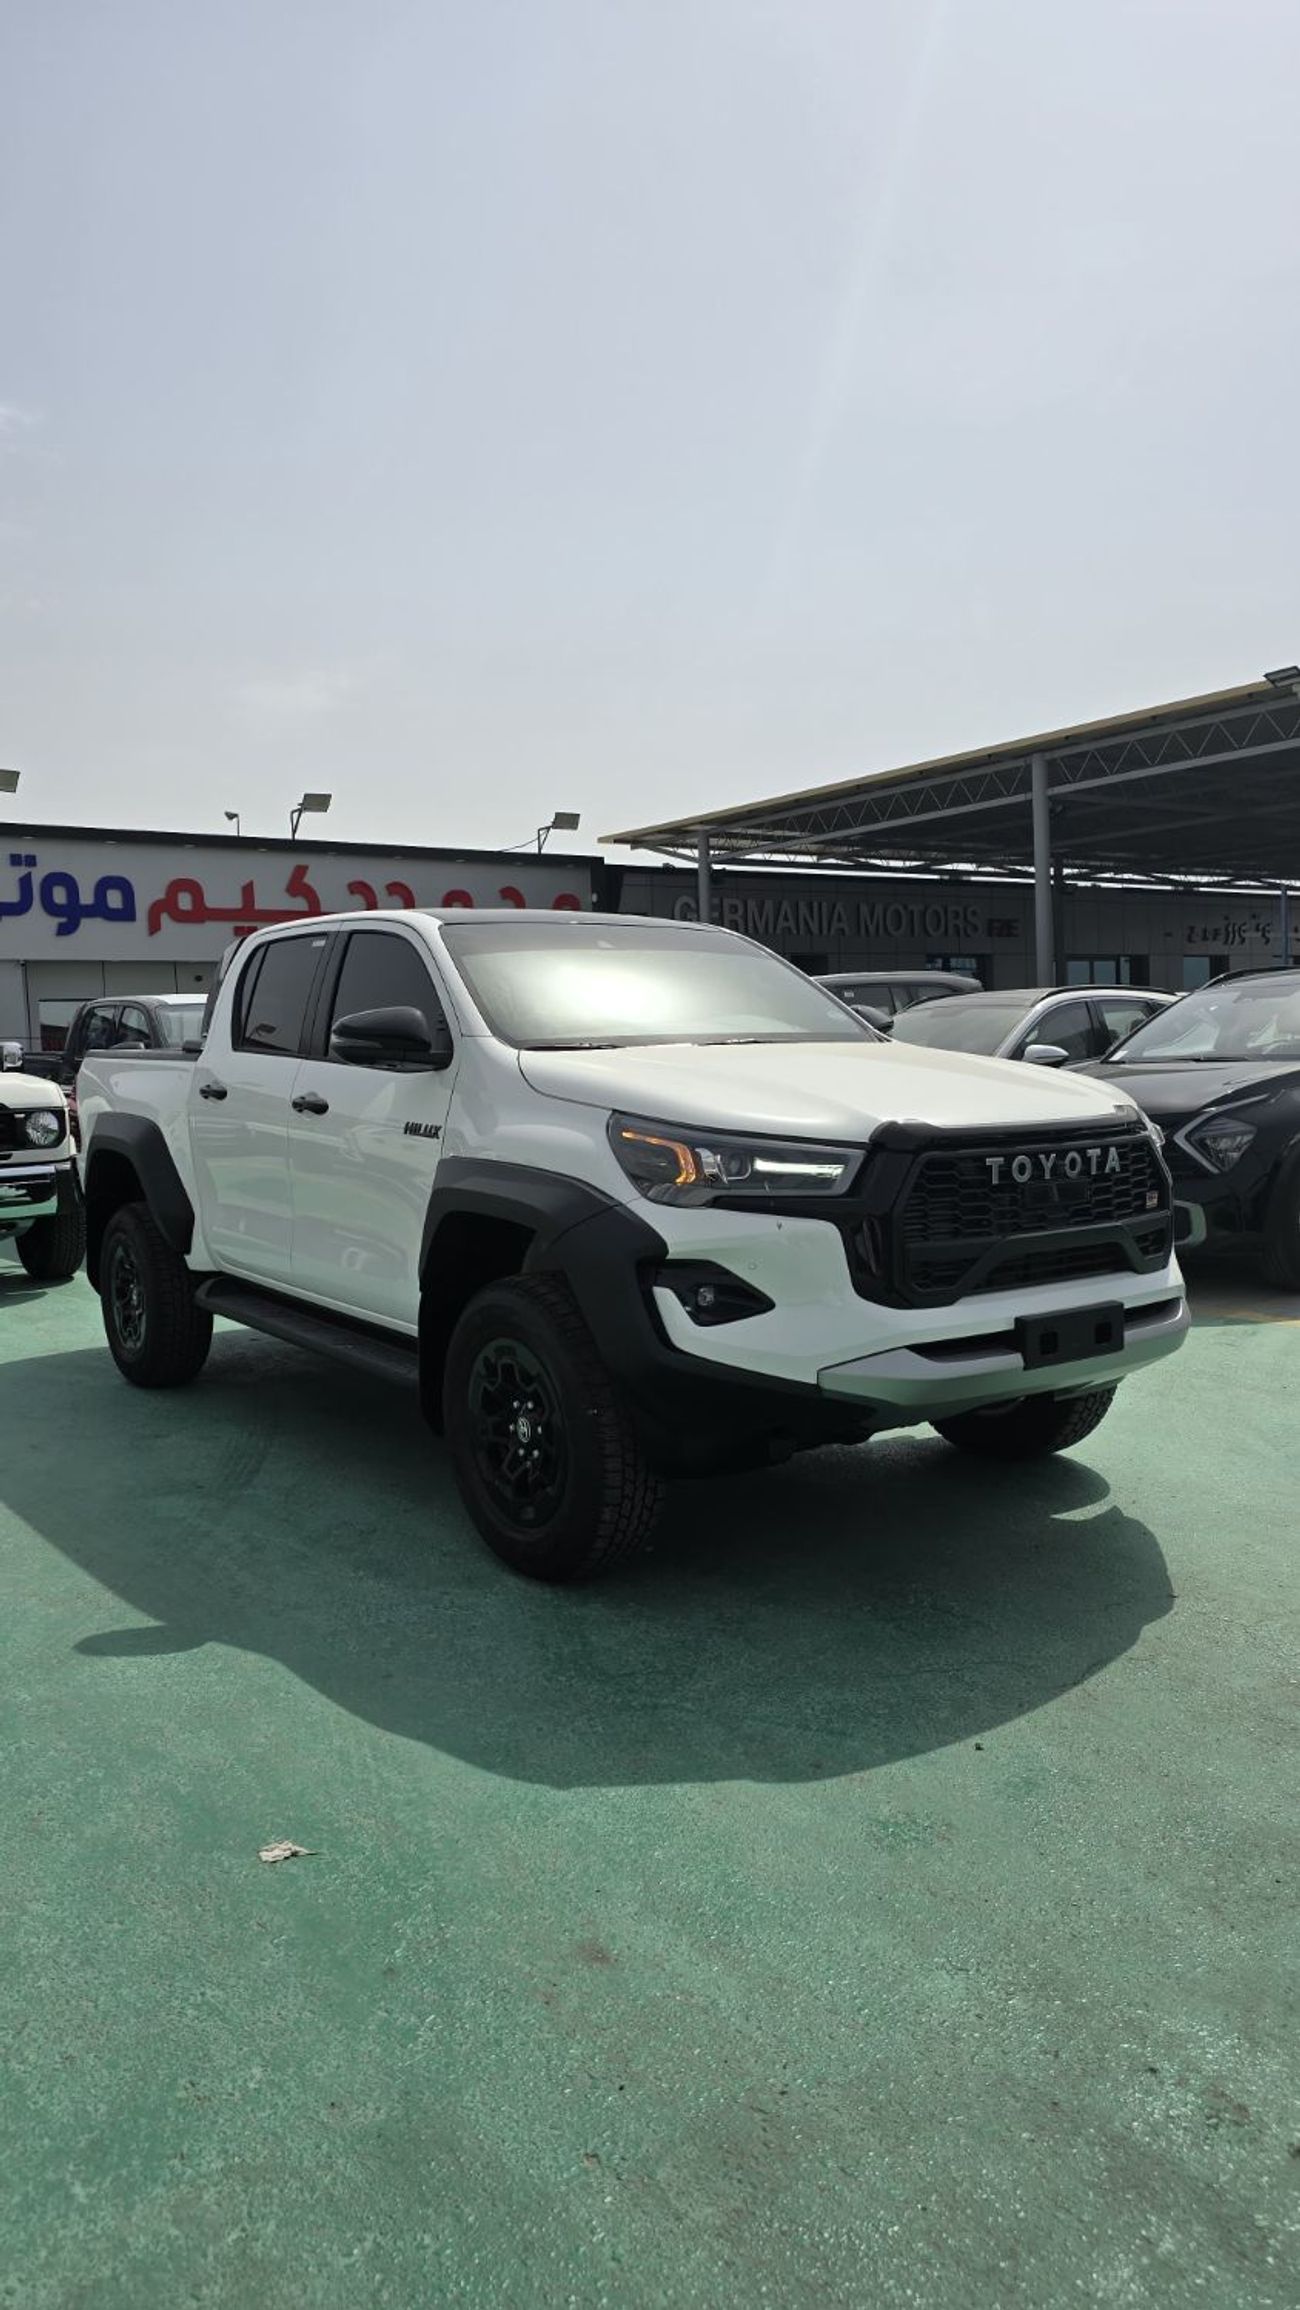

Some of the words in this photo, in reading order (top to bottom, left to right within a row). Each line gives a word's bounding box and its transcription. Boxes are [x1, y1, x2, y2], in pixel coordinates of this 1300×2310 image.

[0, 853, 137, 937] موت
[858, 901, 981, 938] MOTORS
[404, 1121, 442, 1139] HILUX
[985, 1146, 1121, 1184] TOYOTA
